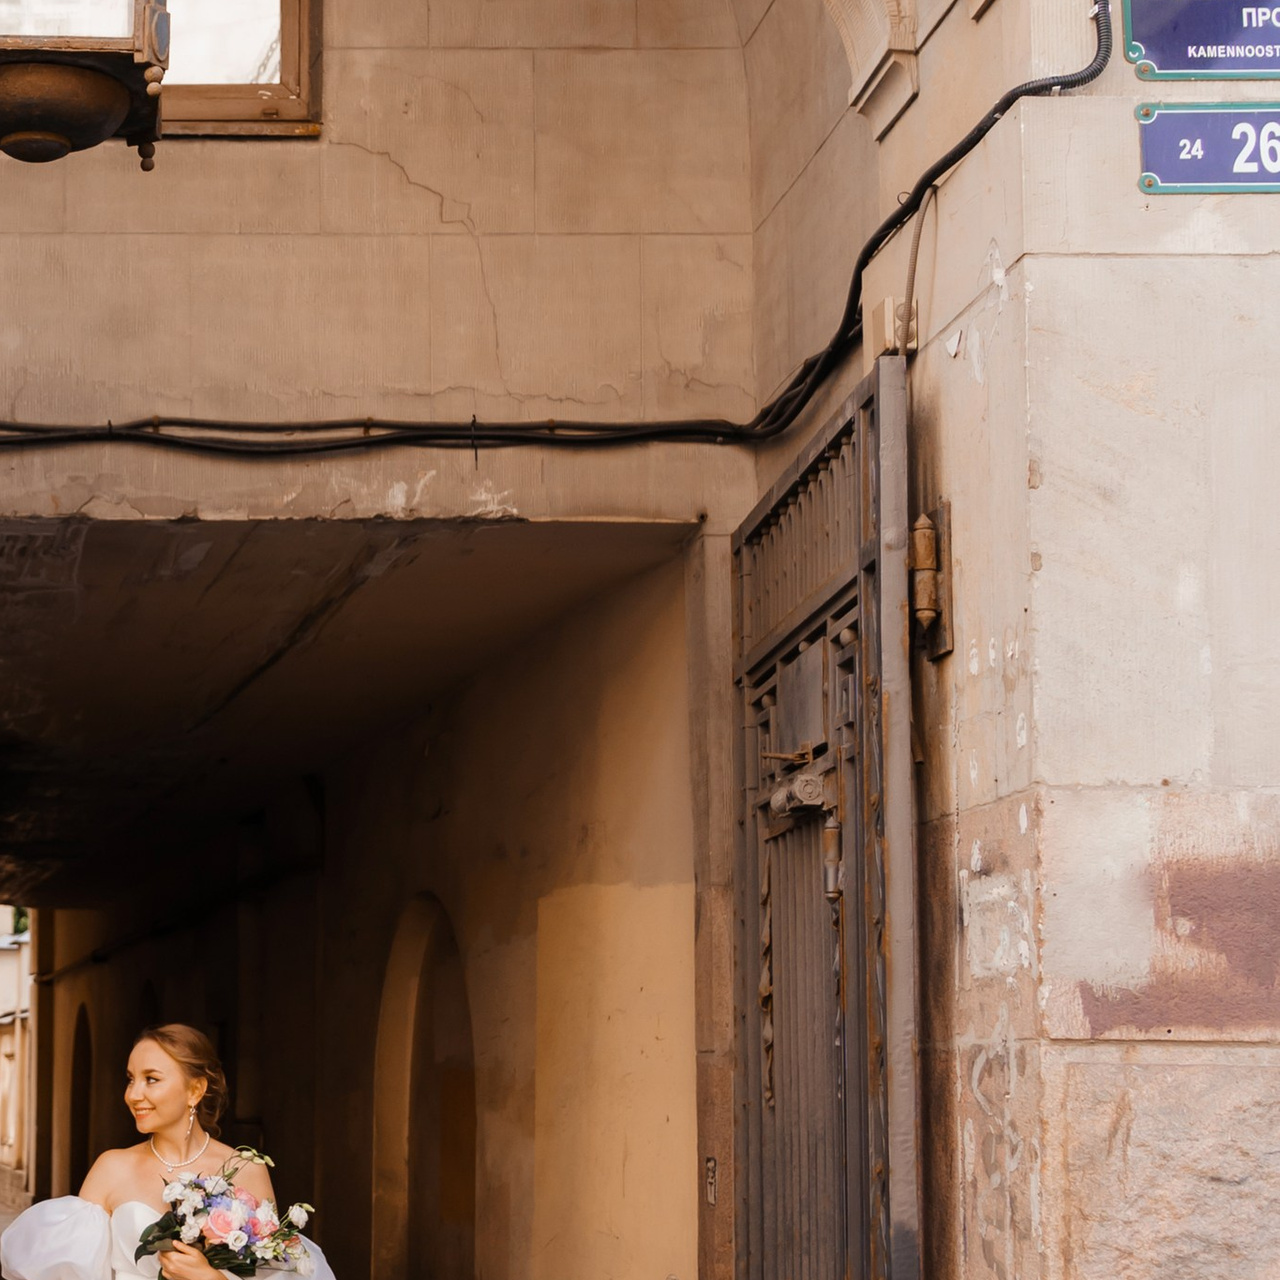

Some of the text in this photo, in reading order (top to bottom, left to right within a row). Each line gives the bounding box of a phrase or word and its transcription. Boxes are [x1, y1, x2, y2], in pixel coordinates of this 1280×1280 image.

[1187, 45, 1280, 58] KAMENNOOST
[1179, 121, 1280, 174] 24 26
